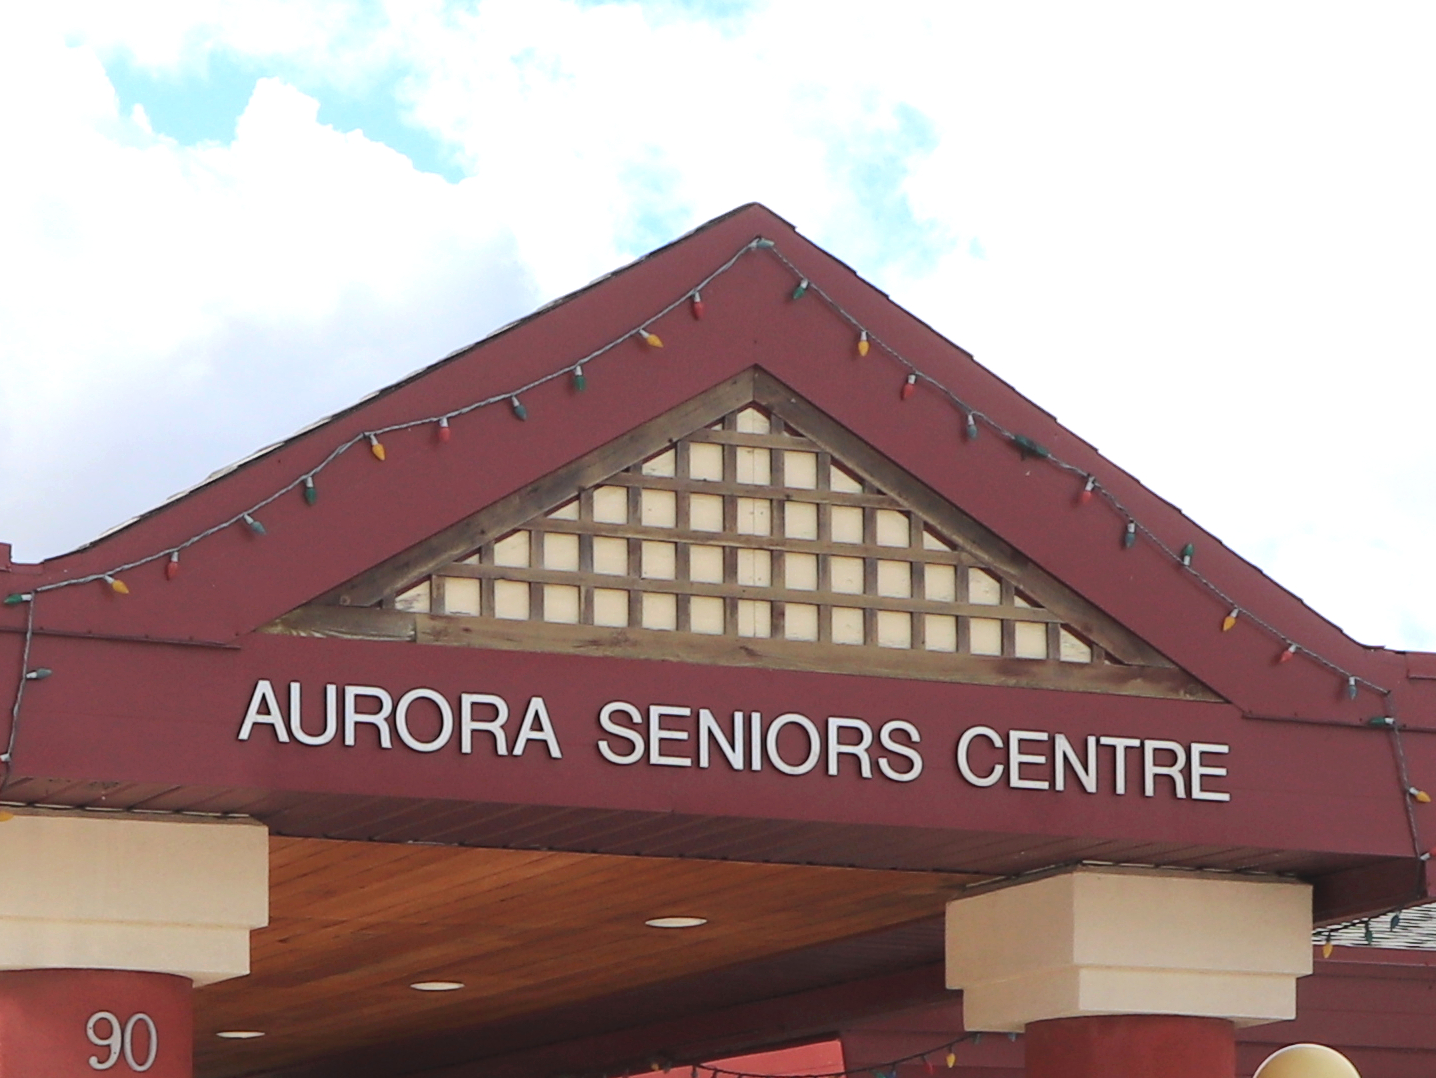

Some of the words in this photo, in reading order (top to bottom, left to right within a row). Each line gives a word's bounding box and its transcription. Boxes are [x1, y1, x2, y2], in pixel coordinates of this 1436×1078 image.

[237, 678, 563, 760] AURORA
[596, 700, 924, 783] SENIORS
[956, 725, 1232, 803] CENTRE
[86, 1011, 158, 1072] 90
